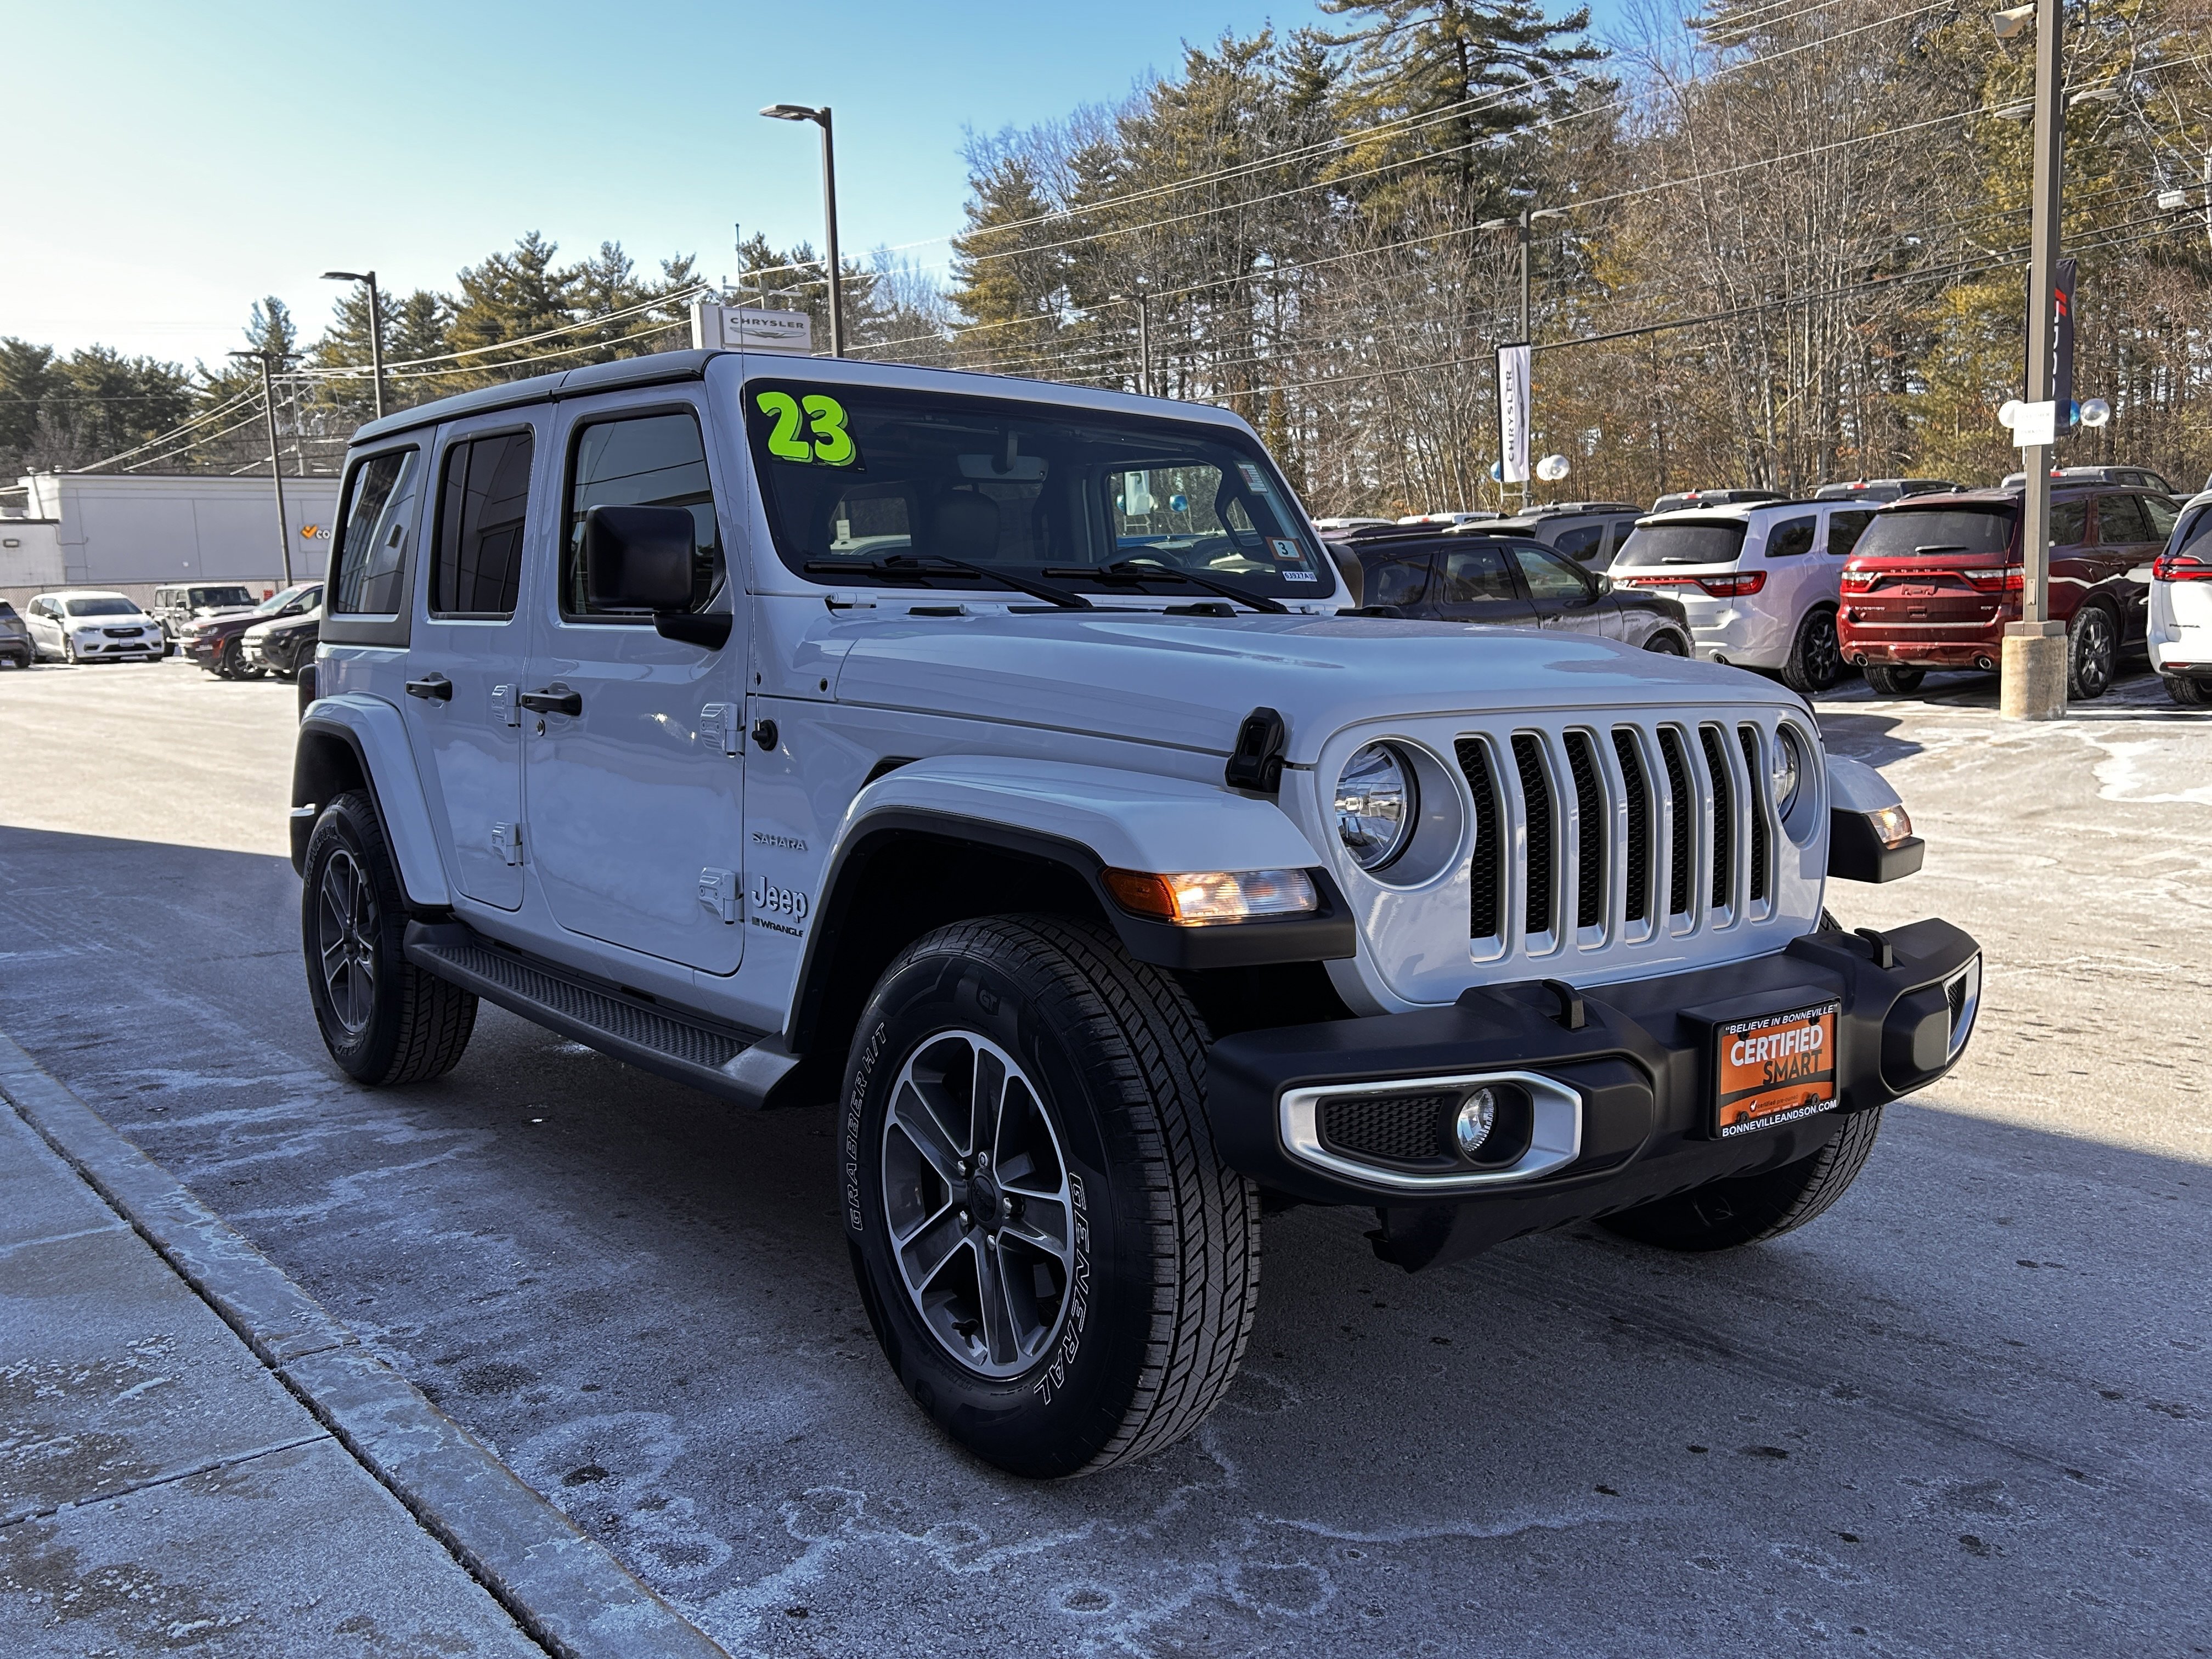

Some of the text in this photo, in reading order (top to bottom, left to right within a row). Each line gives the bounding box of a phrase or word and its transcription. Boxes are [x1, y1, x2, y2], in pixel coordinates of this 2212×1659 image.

[730, 317, 804, 329] CHRYSLER
[756, 391, 856, 466] 23
[1505, 370, 1514, 461] CHRYSLER
[1278, 541, 1289, 555] 3
[752, 832, 808, 851] SAHARA
[751, 876, 809, 923] Jeep
[760, 918, 804, 938] WRANGLE
[1771, 1017, 1781, 1026] IN
[1731, 1025, 1823, 1066] CERTIFIED
[1763, 1049, 1823, 1085] SMART
[1723, 1099, 1837, 1137] BONNEVILLEANDSON.COM
[846, 1071, 867, 1231] GRABBER
[1033, 1172, 1090, 1406] GENERAL
